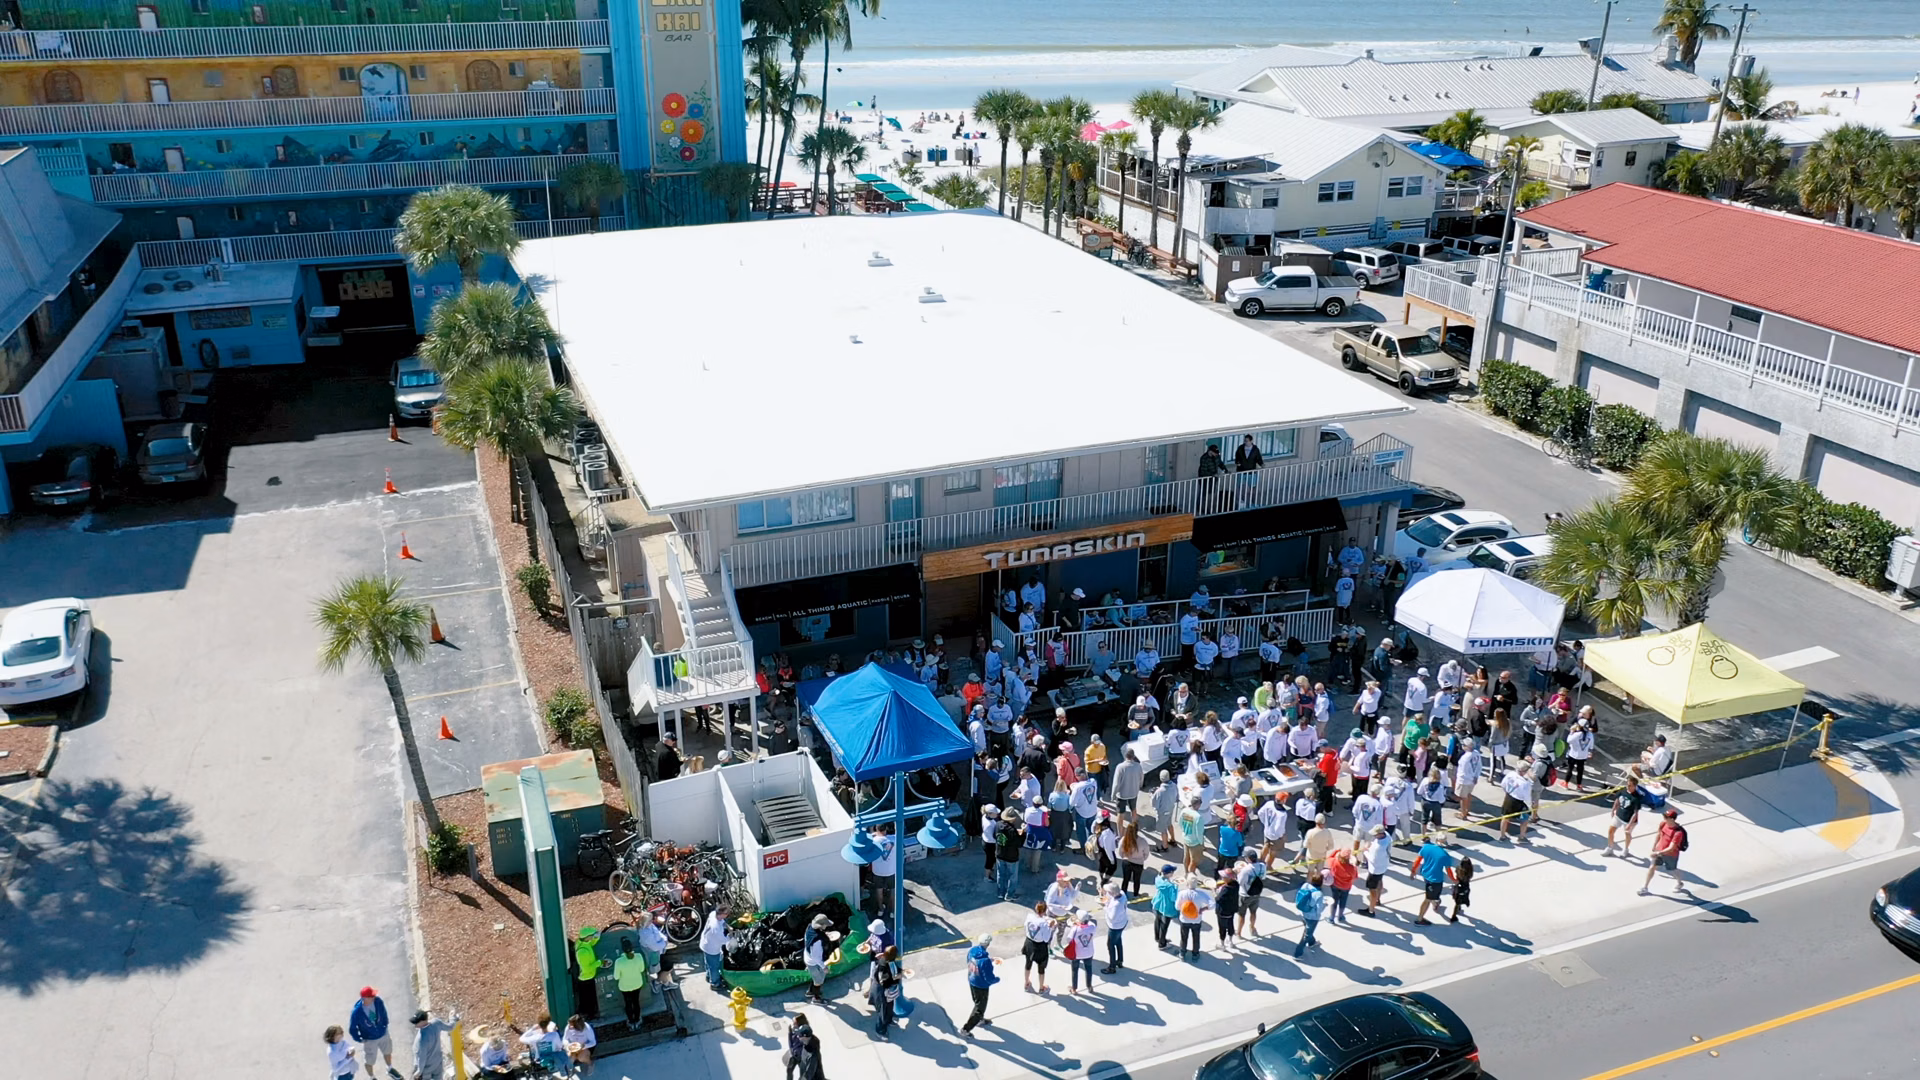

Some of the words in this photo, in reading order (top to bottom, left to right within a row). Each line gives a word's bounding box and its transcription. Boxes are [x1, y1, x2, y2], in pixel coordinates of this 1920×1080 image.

[656, 12, 700, 31] KAI
[664, 34, 692, 42] BAR
[1253, 534, 1276, 542] THINGS
[1277, 530, 1303, 539] AQUATIC
[983, 532, 1145, 569] TUNASKIN
[808, 605, 835, 614] THINGS
[837, 600, 868, 610] AQUATIC
[1468, 637, 1553, 648] TUNASKIN
[766, 853, 786, 866] FDC
